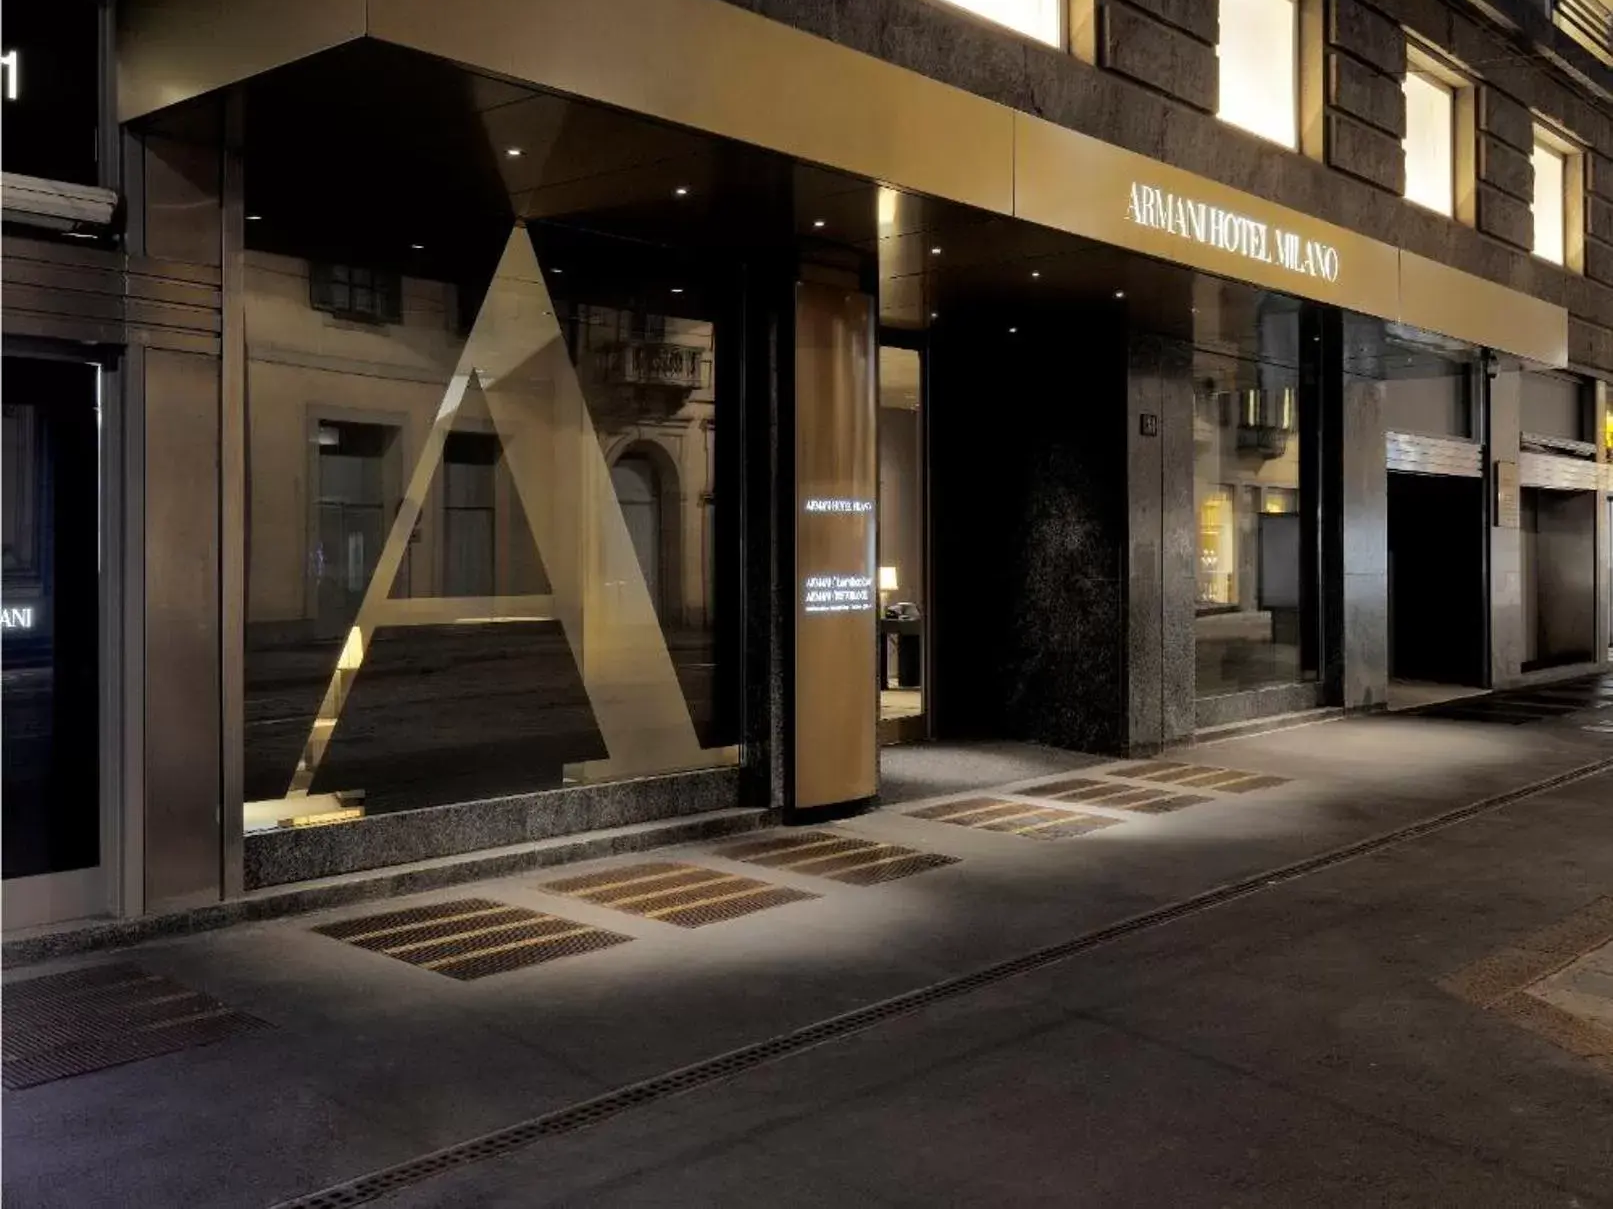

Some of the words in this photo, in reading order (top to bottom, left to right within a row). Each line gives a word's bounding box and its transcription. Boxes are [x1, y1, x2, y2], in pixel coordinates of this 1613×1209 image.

[1124, 181, 1207, 243] ARMANI
[1208, 207, 1272, 263] HOTEL
[1273, 229, 1339, 282] MILANO
